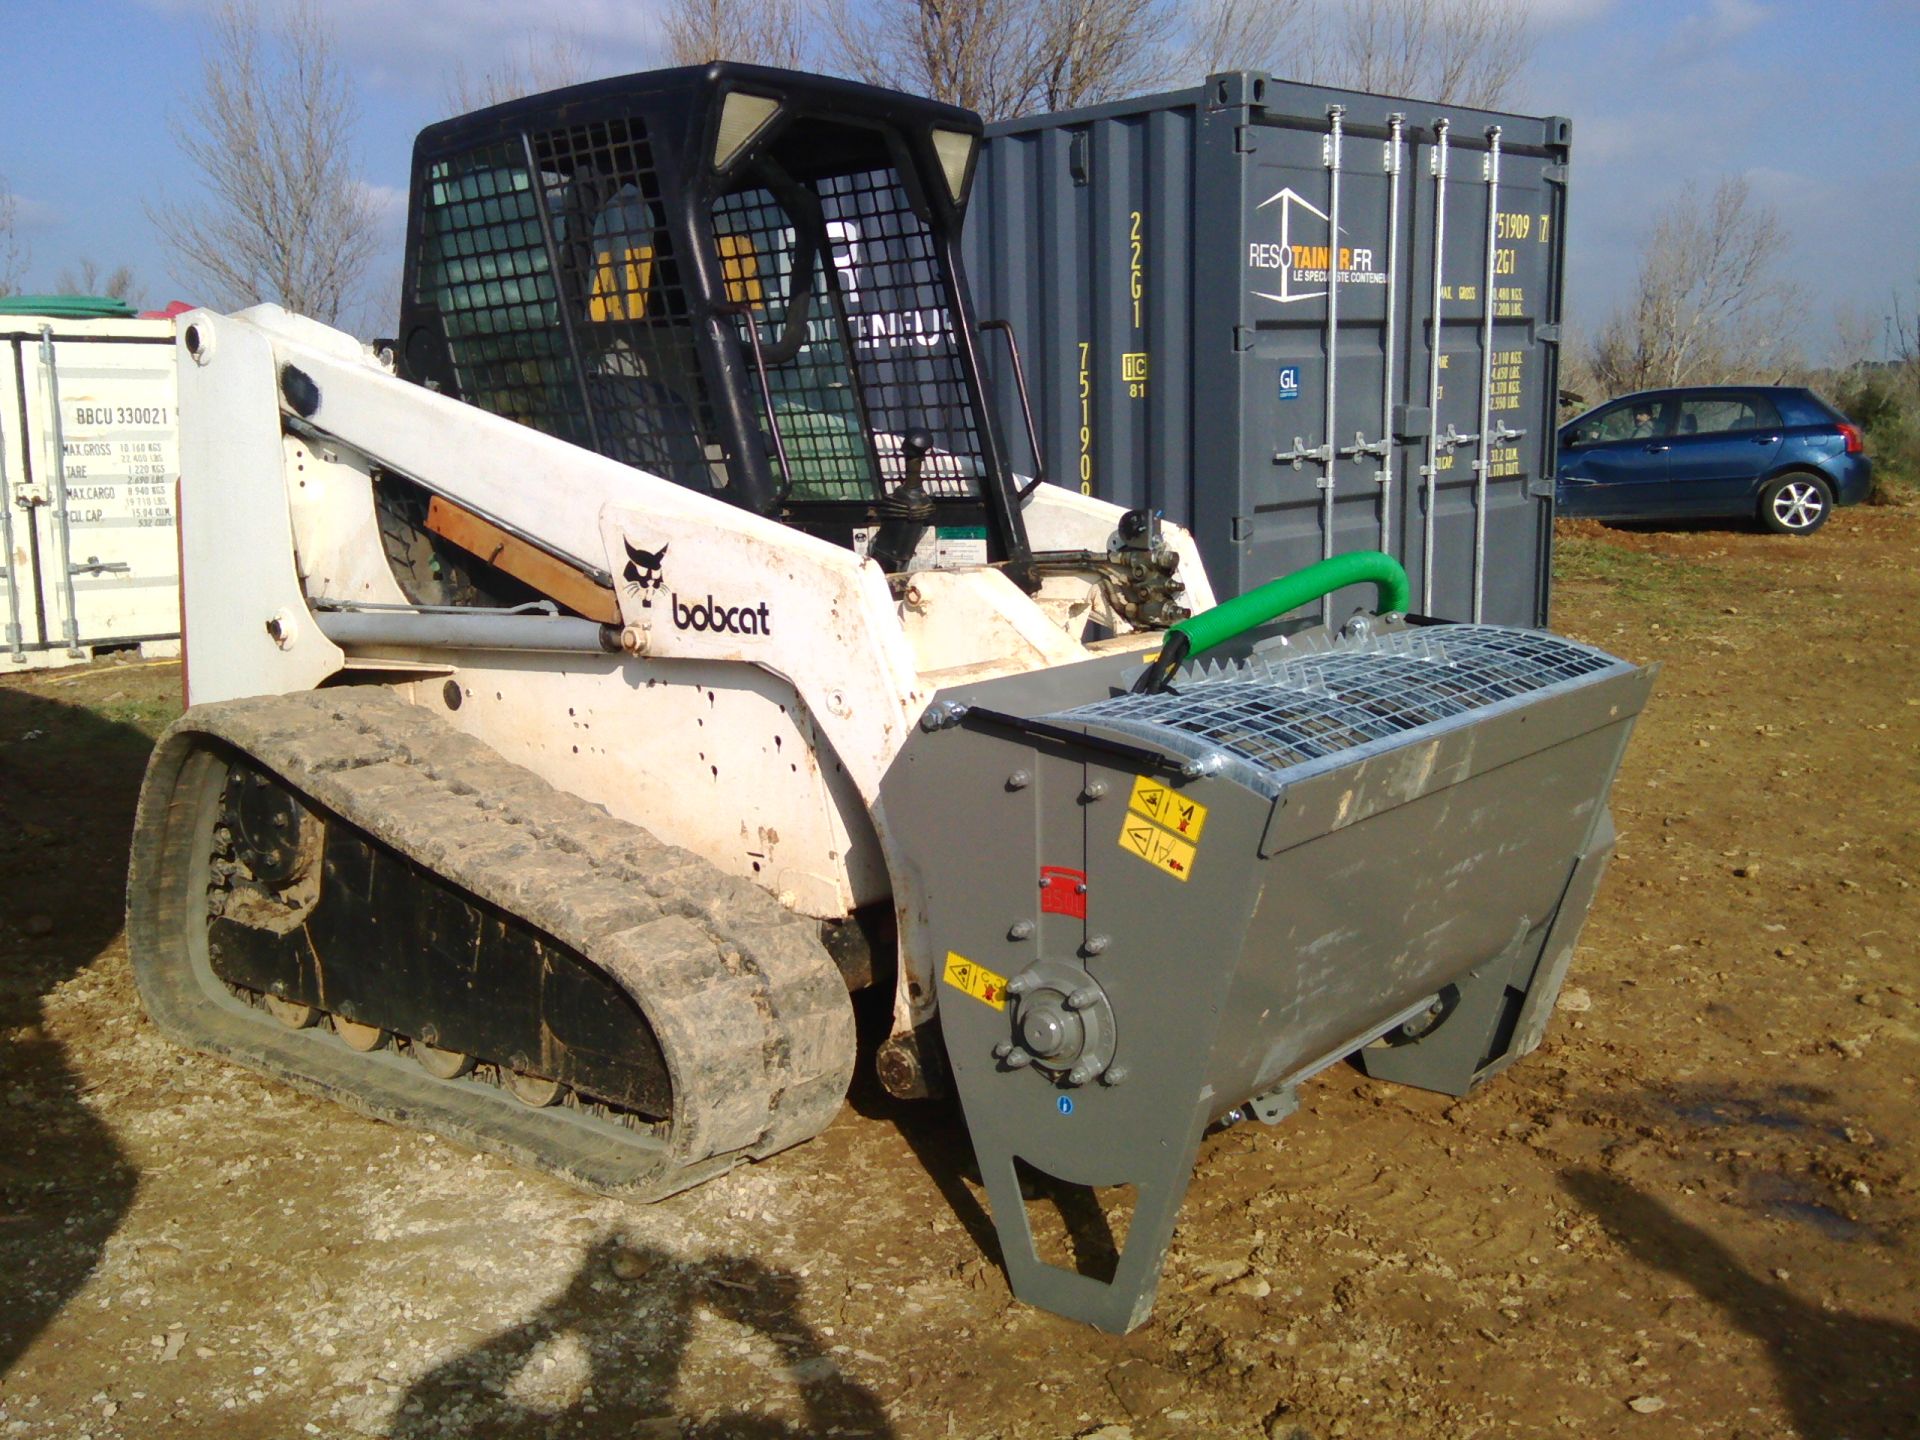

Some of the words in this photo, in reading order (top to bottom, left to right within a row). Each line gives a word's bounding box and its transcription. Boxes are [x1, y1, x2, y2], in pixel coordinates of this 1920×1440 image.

[1495, 213, 1530, 239] 51909
[1540, 215, 1549, 242] 7
[1249, 243, 1372, 271] RESOTAINR.FR
[1493, 249, 1515, 274] 2G1
[1130, 211, 1142, 328] 22G1
[1293, 269, 1303, 281] LE
[1304, 270, 1350, 283] SPECISTE
[1459, 286, 1476, 300] GROSS
[1280, 369, 1297, 389] GL
[1129, 383, 1145, 398] 81
[77, 407, 113, 425] BBCU
[117, 407, 167, 425] 330021
[66, 466, 87, 479] TARE
[134, 464, 150, 474] 220
[151, 464, 165, 474] KGS
[672, 592, 770, 635] bobcat
